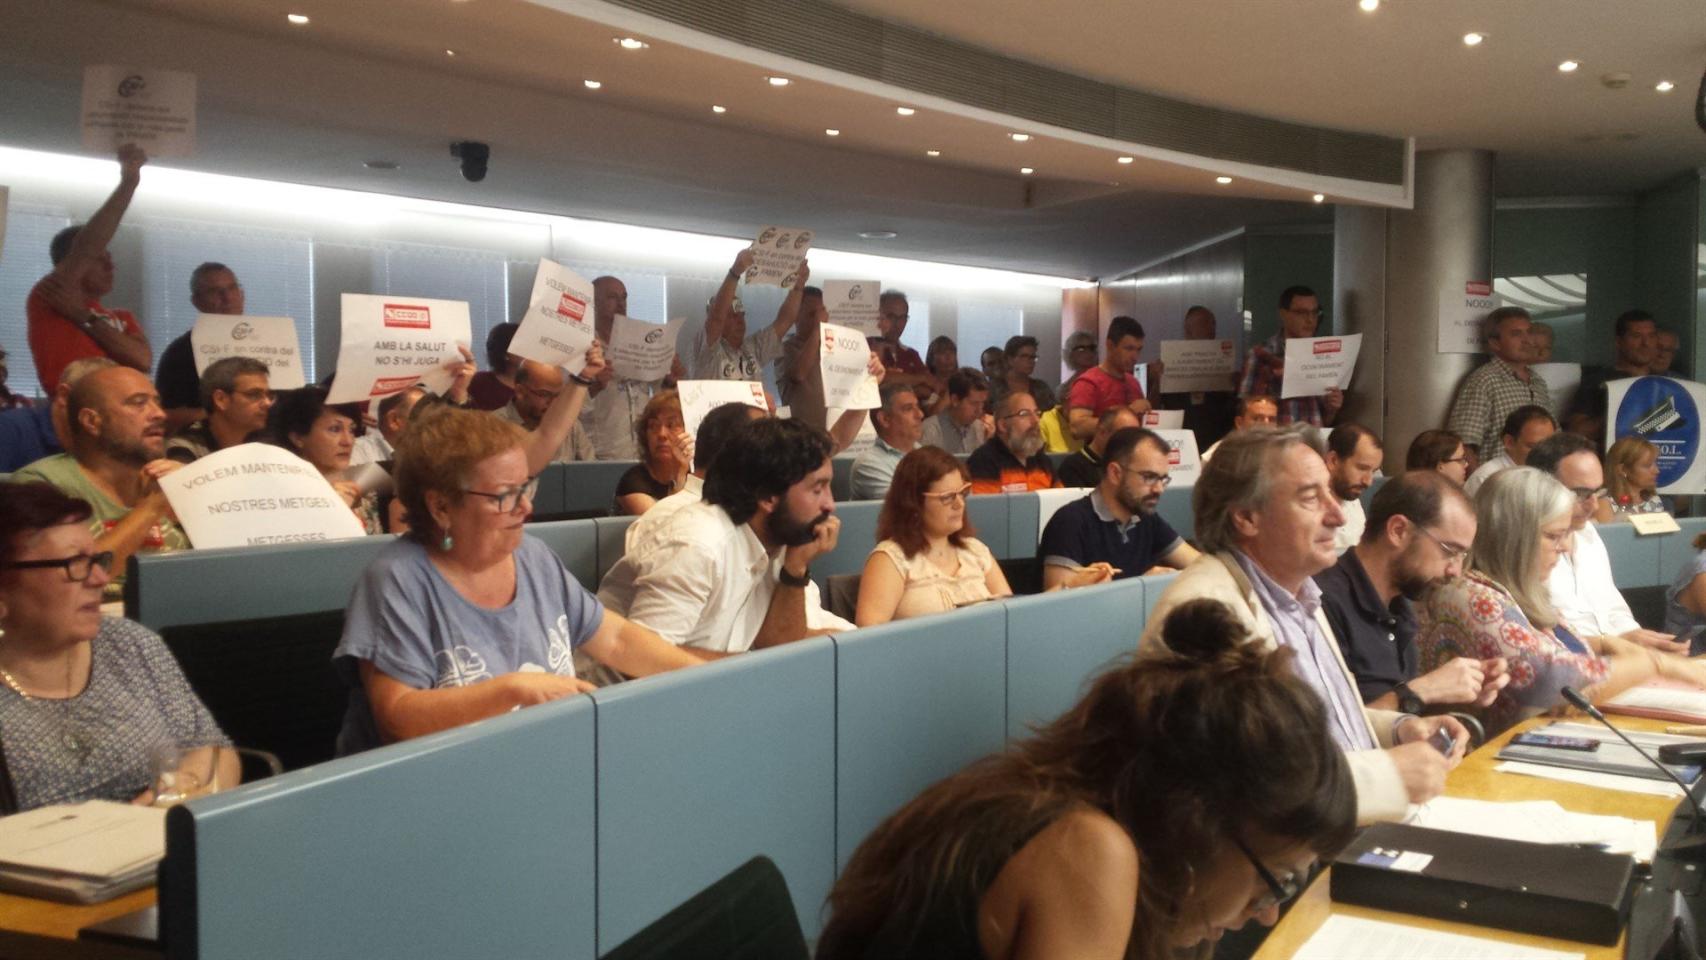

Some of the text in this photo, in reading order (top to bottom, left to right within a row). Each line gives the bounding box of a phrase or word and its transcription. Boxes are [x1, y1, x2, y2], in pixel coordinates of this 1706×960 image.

[374, 341, 447, 352] AMB LA SALUT
[374, 356, 391, 365] NO
[414, 356, 440, 365] JUGA
[182, 465, 239, 490] VOLEM
[207, 497, 277, 515] NOSTRES
[278, 497, 330, 509] METGES
[247, 532, 326, 546] METGESSES
